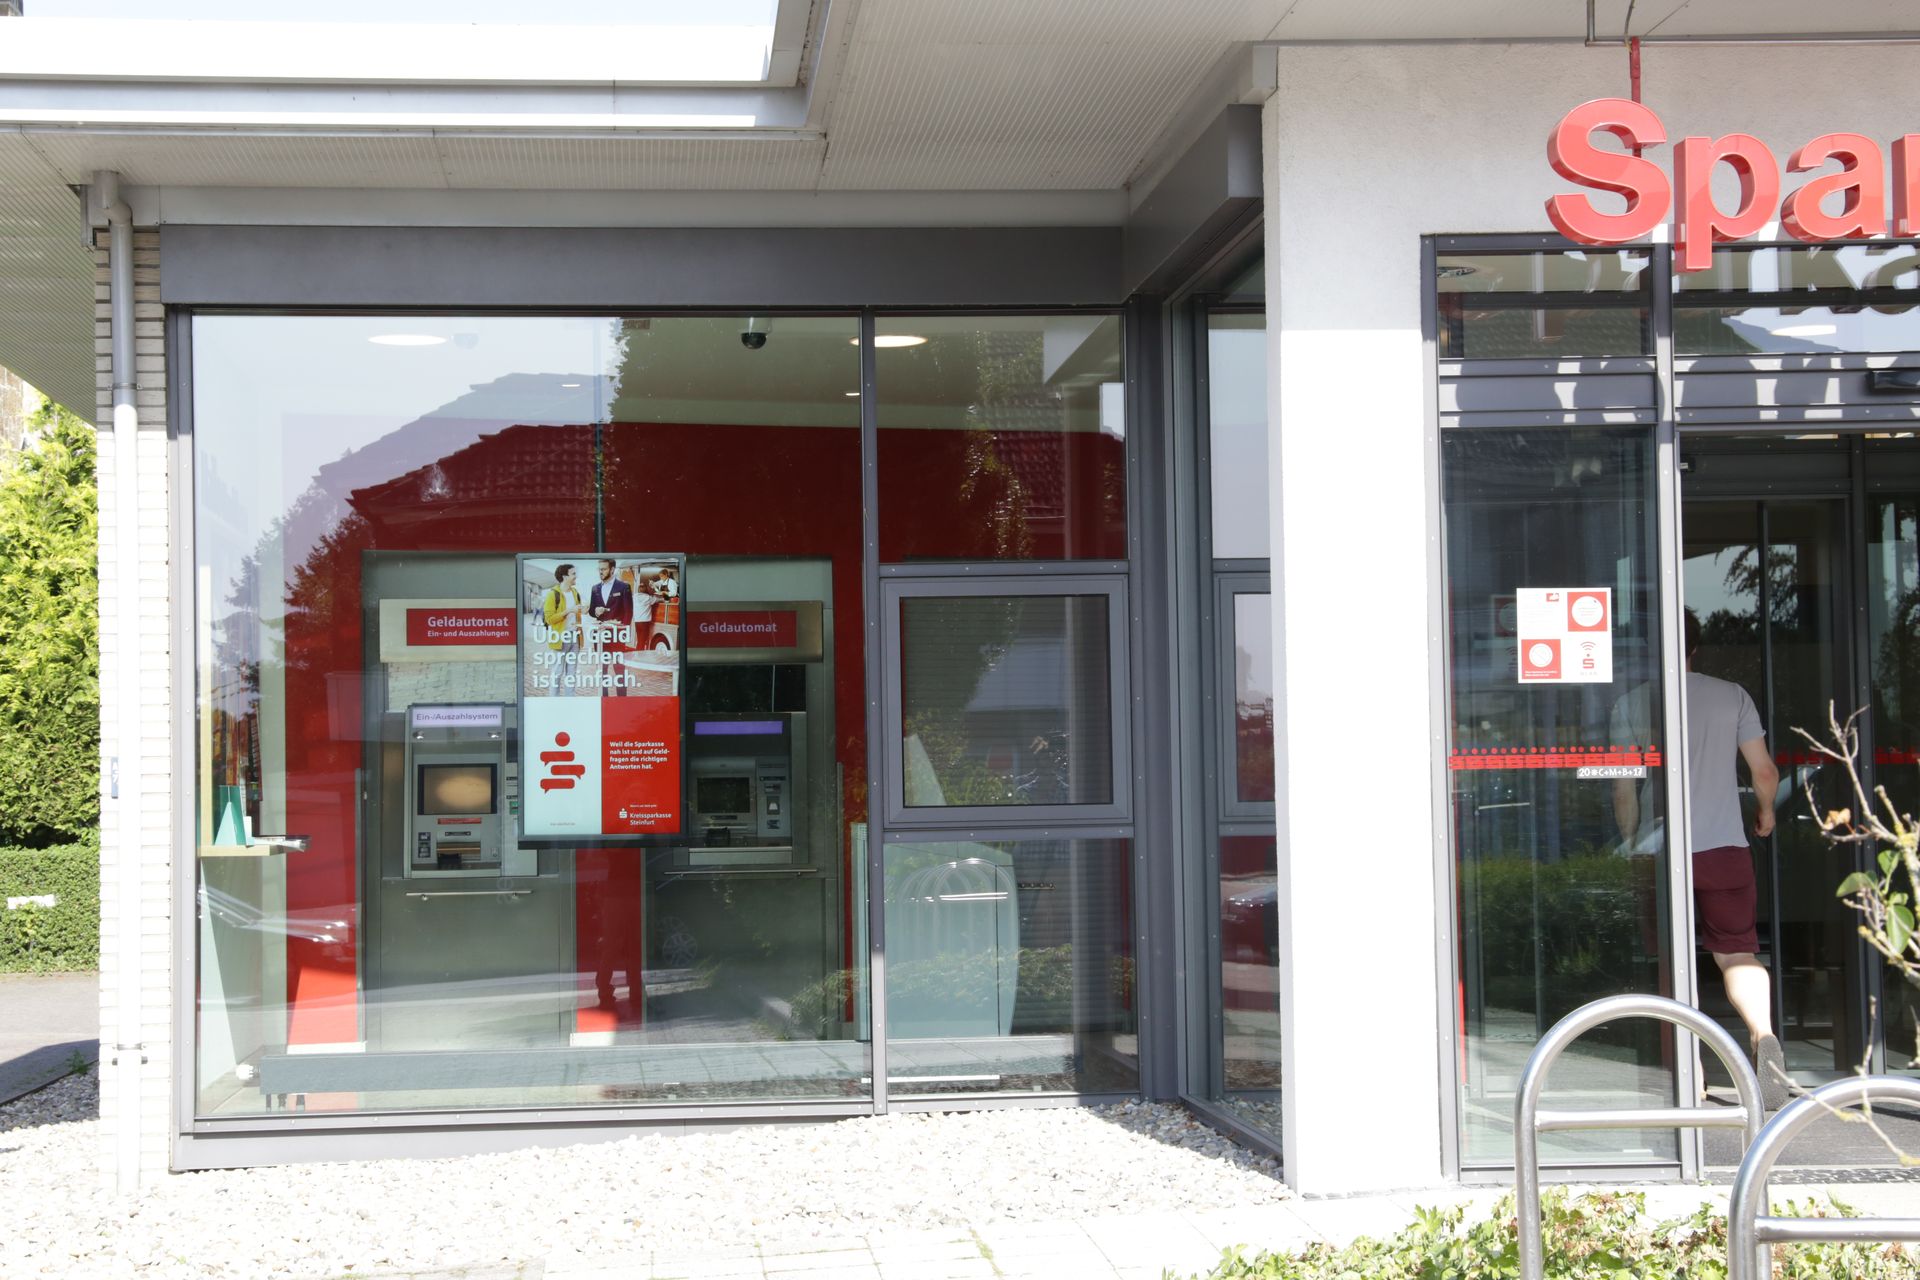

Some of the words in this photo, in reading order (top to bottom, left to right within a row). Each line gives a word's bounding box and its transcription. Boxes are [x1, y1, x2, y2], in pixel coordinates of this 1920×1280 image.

[427, 616, 510, 628] Geldautomat
[699, 622, 778, 633] Geldautomat
[427, 630, 442, 638] Ein-
[443, 630, 458, 638] und
[458, 629, 510, 639] Auszahlungen
[533, 622, 581, 644] Über
[589, 623, 631, 644] Geld
[533, 647, 625, 669] sprechen
[533, 670, 560, 688] ist
[563, 669, 642, 688] einfach.
[416, 712, 498, 722] Ein-/Auszahlsystem
[634, 741, 665, 749] Sparkasse
